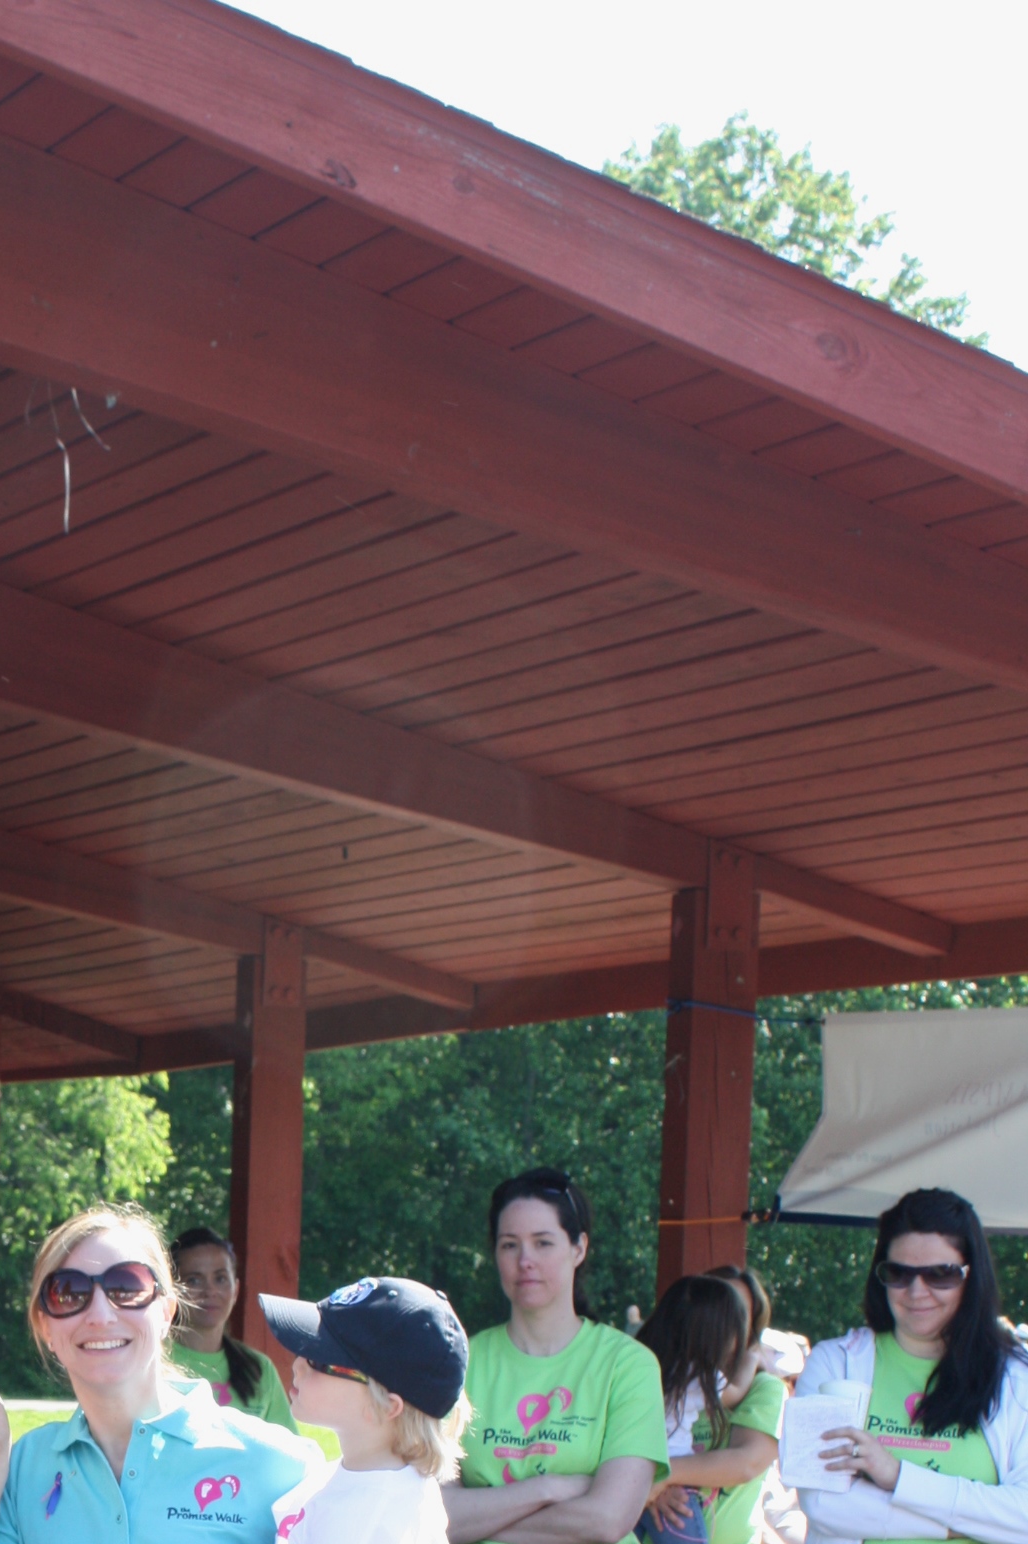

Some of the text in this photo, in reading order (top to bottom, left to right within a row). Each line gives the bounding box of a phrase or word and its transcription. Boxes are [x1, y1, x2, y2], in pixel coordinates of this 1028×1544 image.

[538, 1429, 572, 1443] Walk
[166, 1507, 244, 1525] Promise Walk
